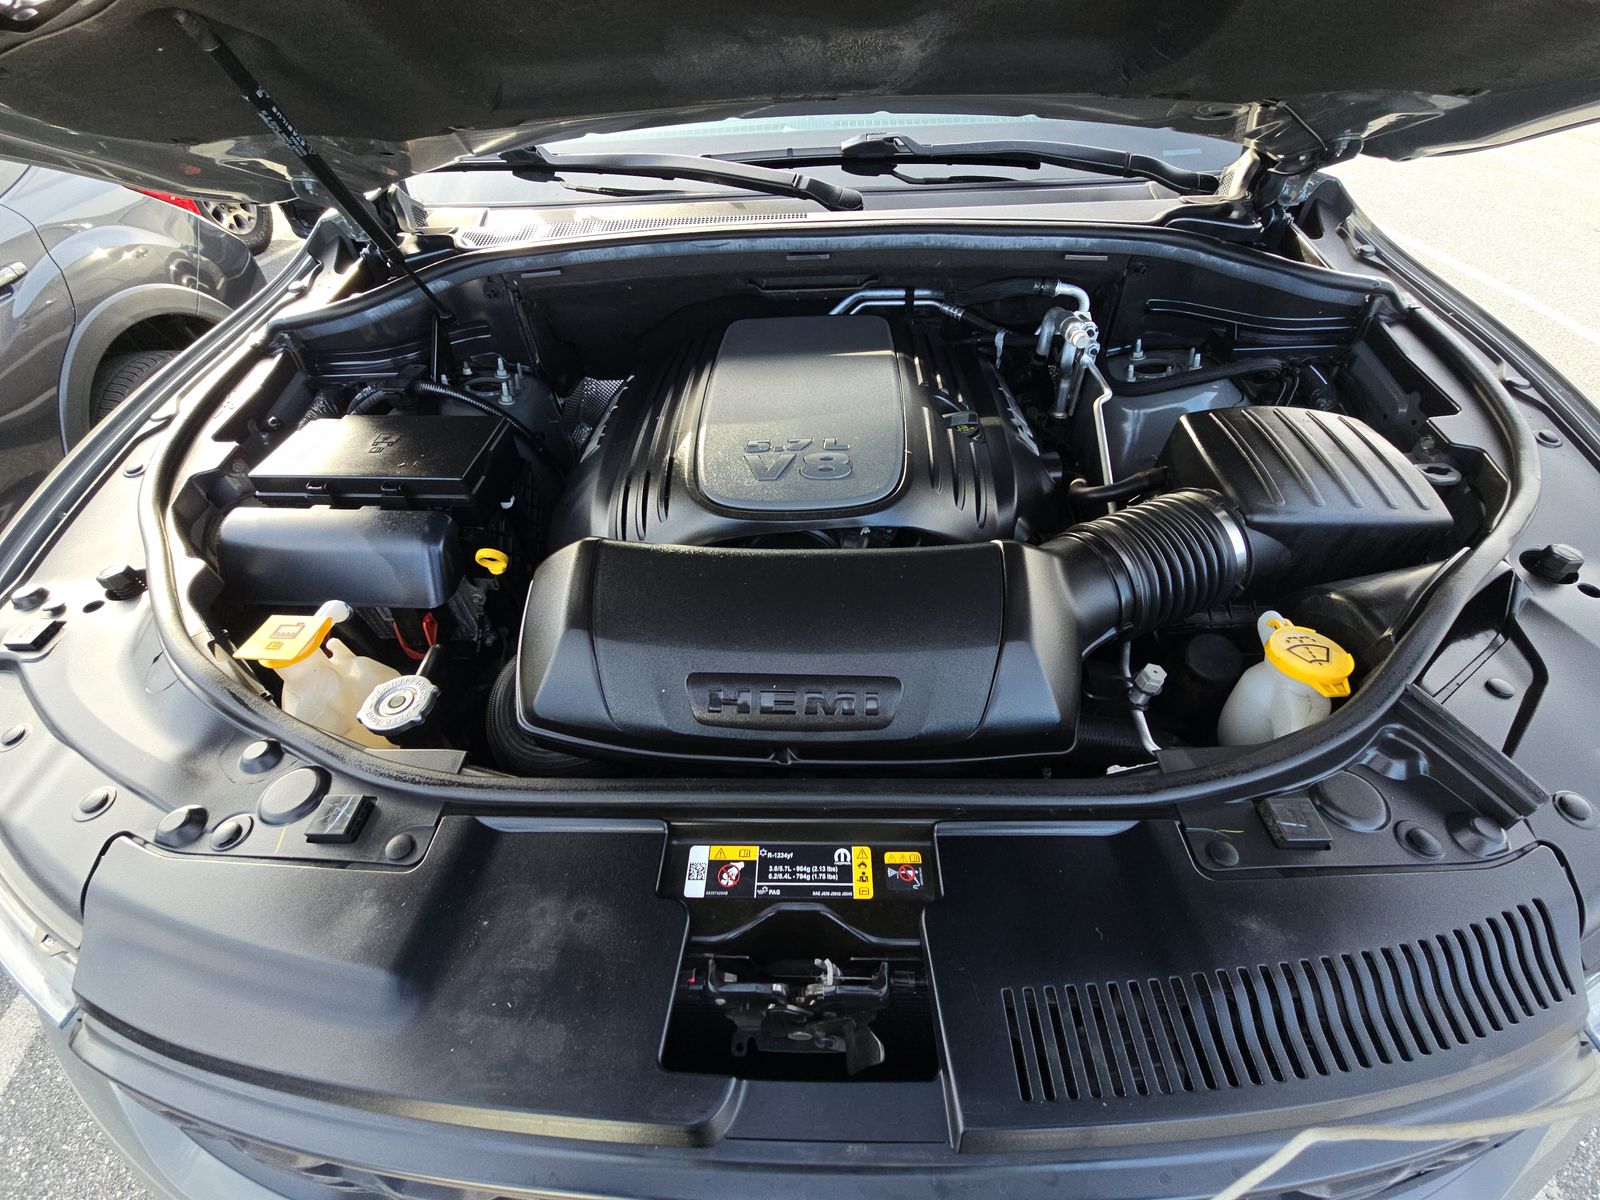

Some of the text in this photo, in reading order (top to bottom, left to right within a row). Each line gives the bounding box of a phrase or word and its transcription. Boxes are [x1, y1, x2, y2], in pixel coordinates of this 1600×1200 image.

[743, 452, 852, 481] V8
[707, 689, 879, 716] HEMI
[767, 852, 794, 860] R-1234yf
